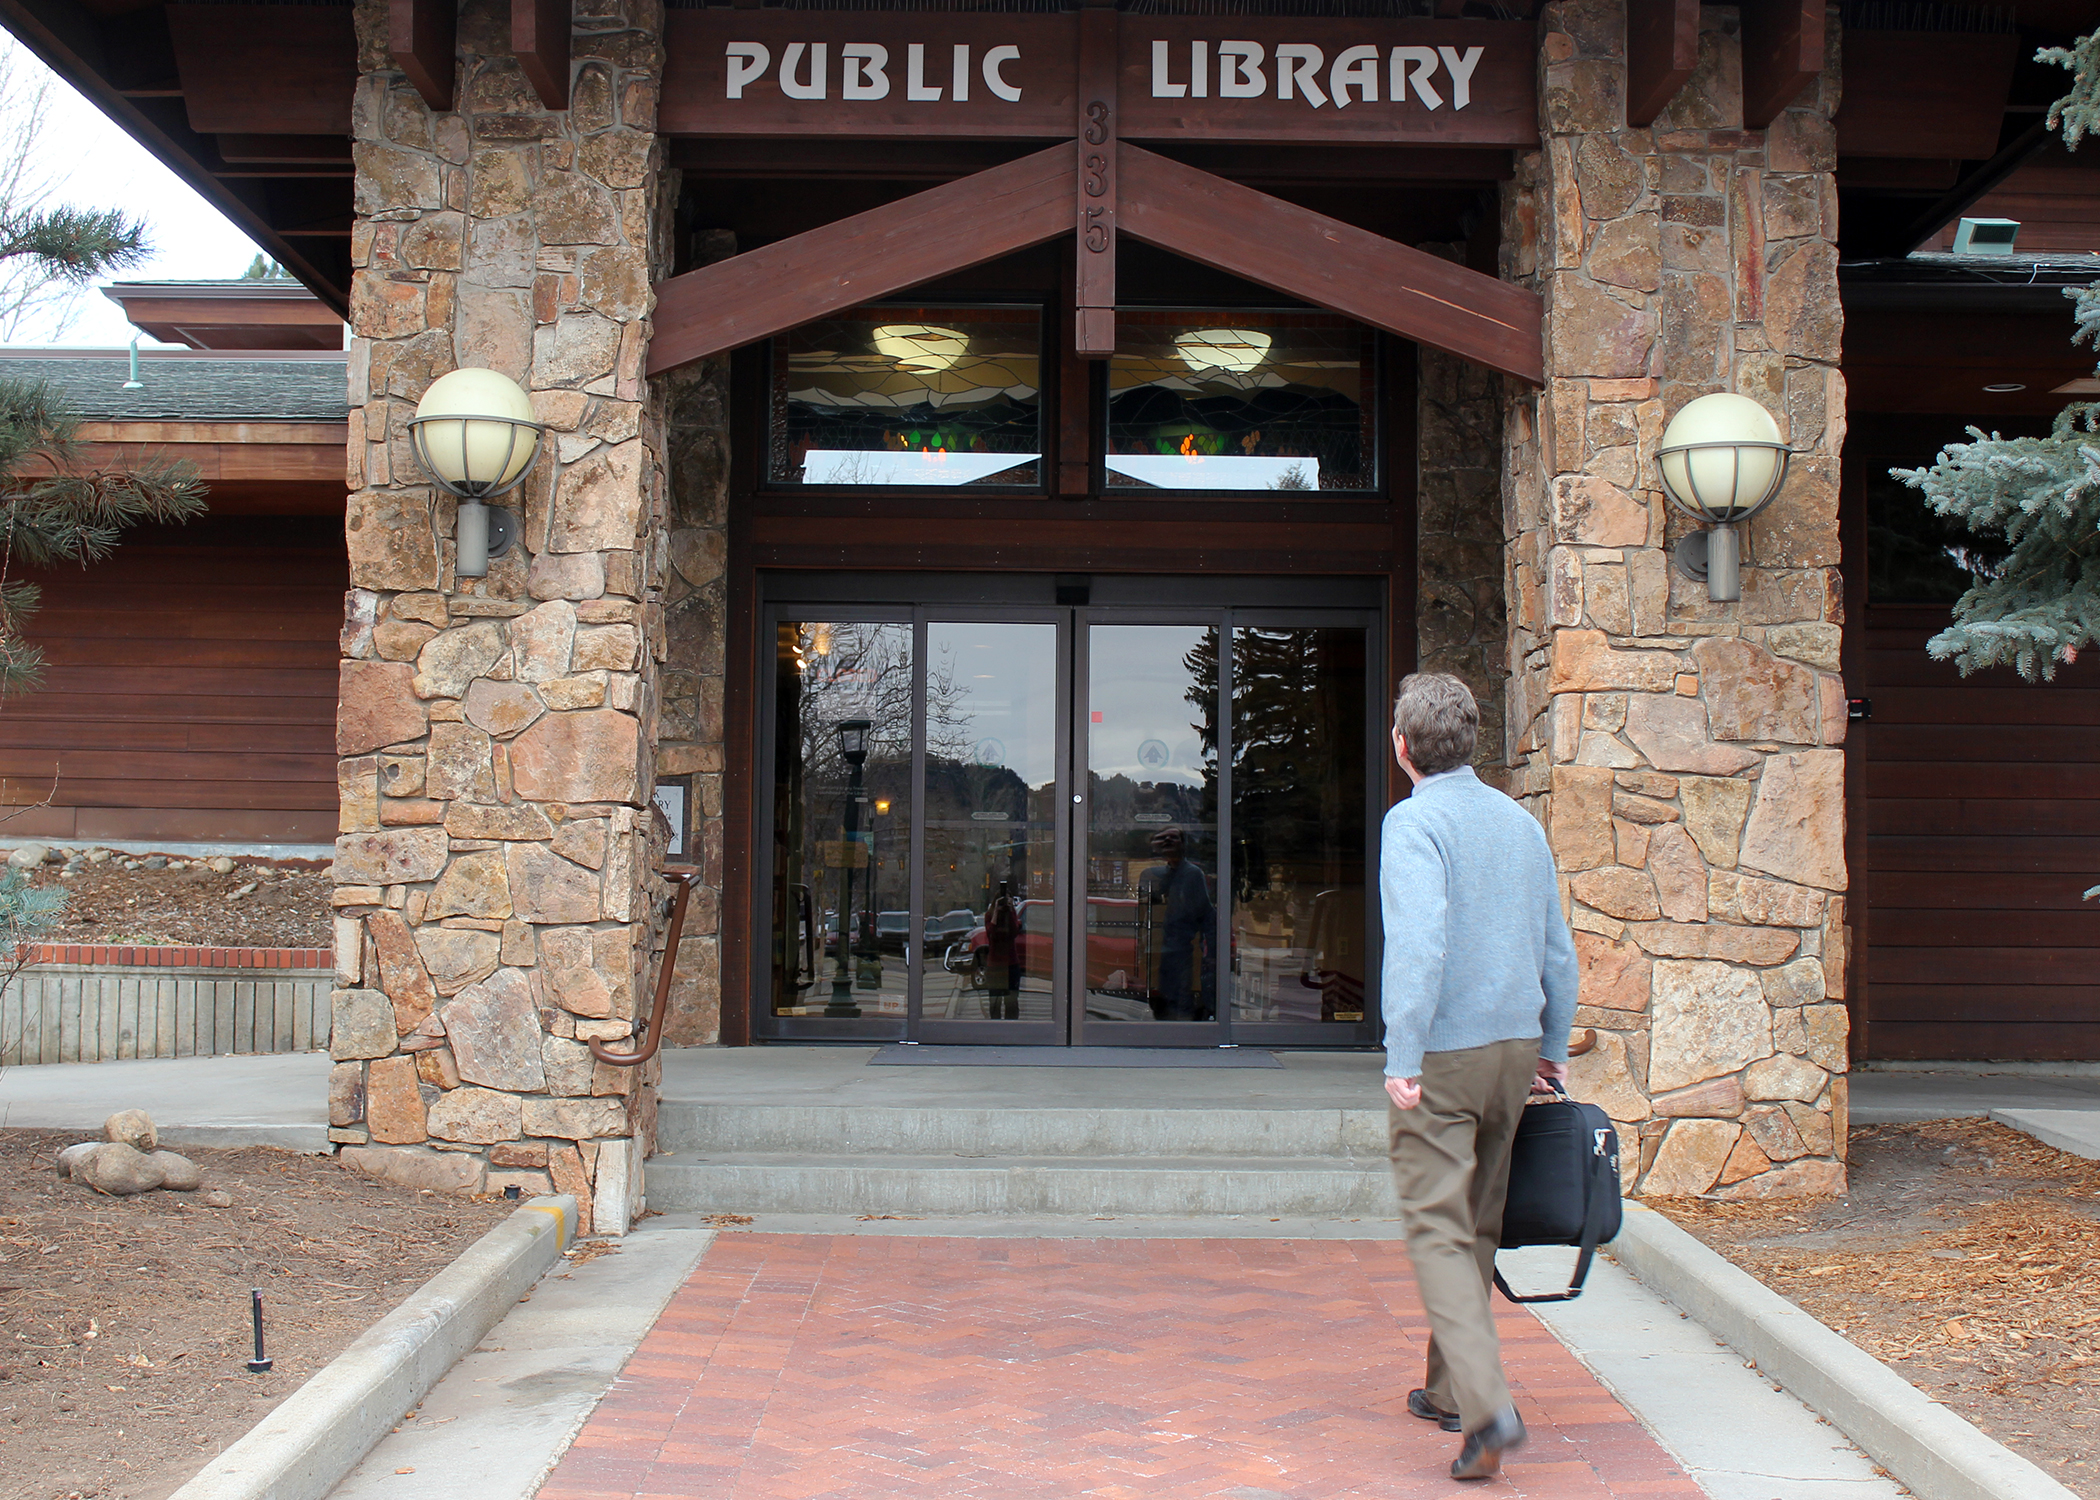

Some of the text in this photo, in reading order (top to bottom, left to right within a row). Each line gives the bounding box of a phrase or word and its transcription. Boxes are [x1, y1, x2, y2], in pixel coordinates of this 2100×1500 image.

[725, 40, 1485, 111] PUBLIC LIBRARY
[1084, 100, 1110, 253] 335
